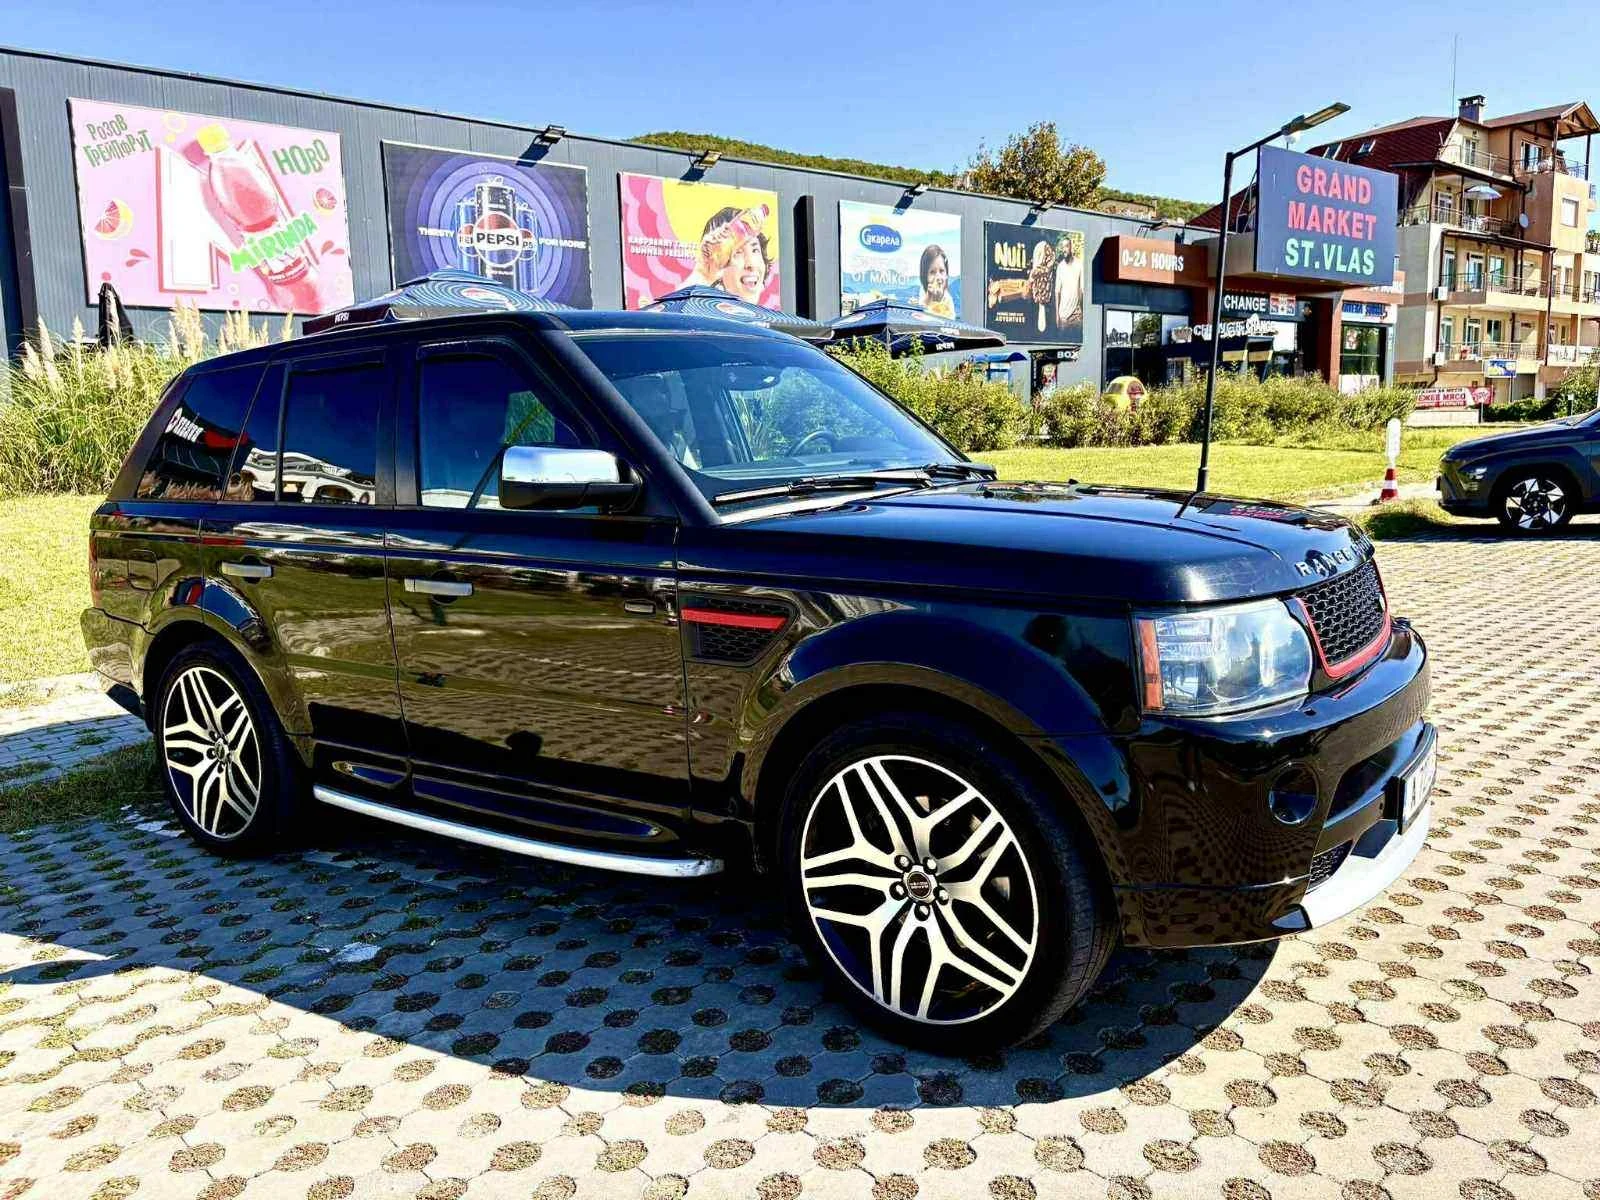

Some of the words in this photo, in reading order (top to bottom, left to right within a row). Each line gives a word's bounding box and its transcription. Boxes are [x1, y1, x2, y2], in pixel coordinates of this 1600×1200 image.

[272, 139, 330, 175] НОВО
[1296, 164, 1372, 205] GRAND
[1287, 200, 1377, 241] MARKET
[476, 232, 520, 246] PEPSI
[1121, 249, 1147, 267] 0-24
[1151, 251, 1184, 272] HOURS
[1285, 238, 1375, 276] ST.VLAS
[1223, 294, 1266, 312] CHANGE
[1294, 547, 1354, 577] RANGE
